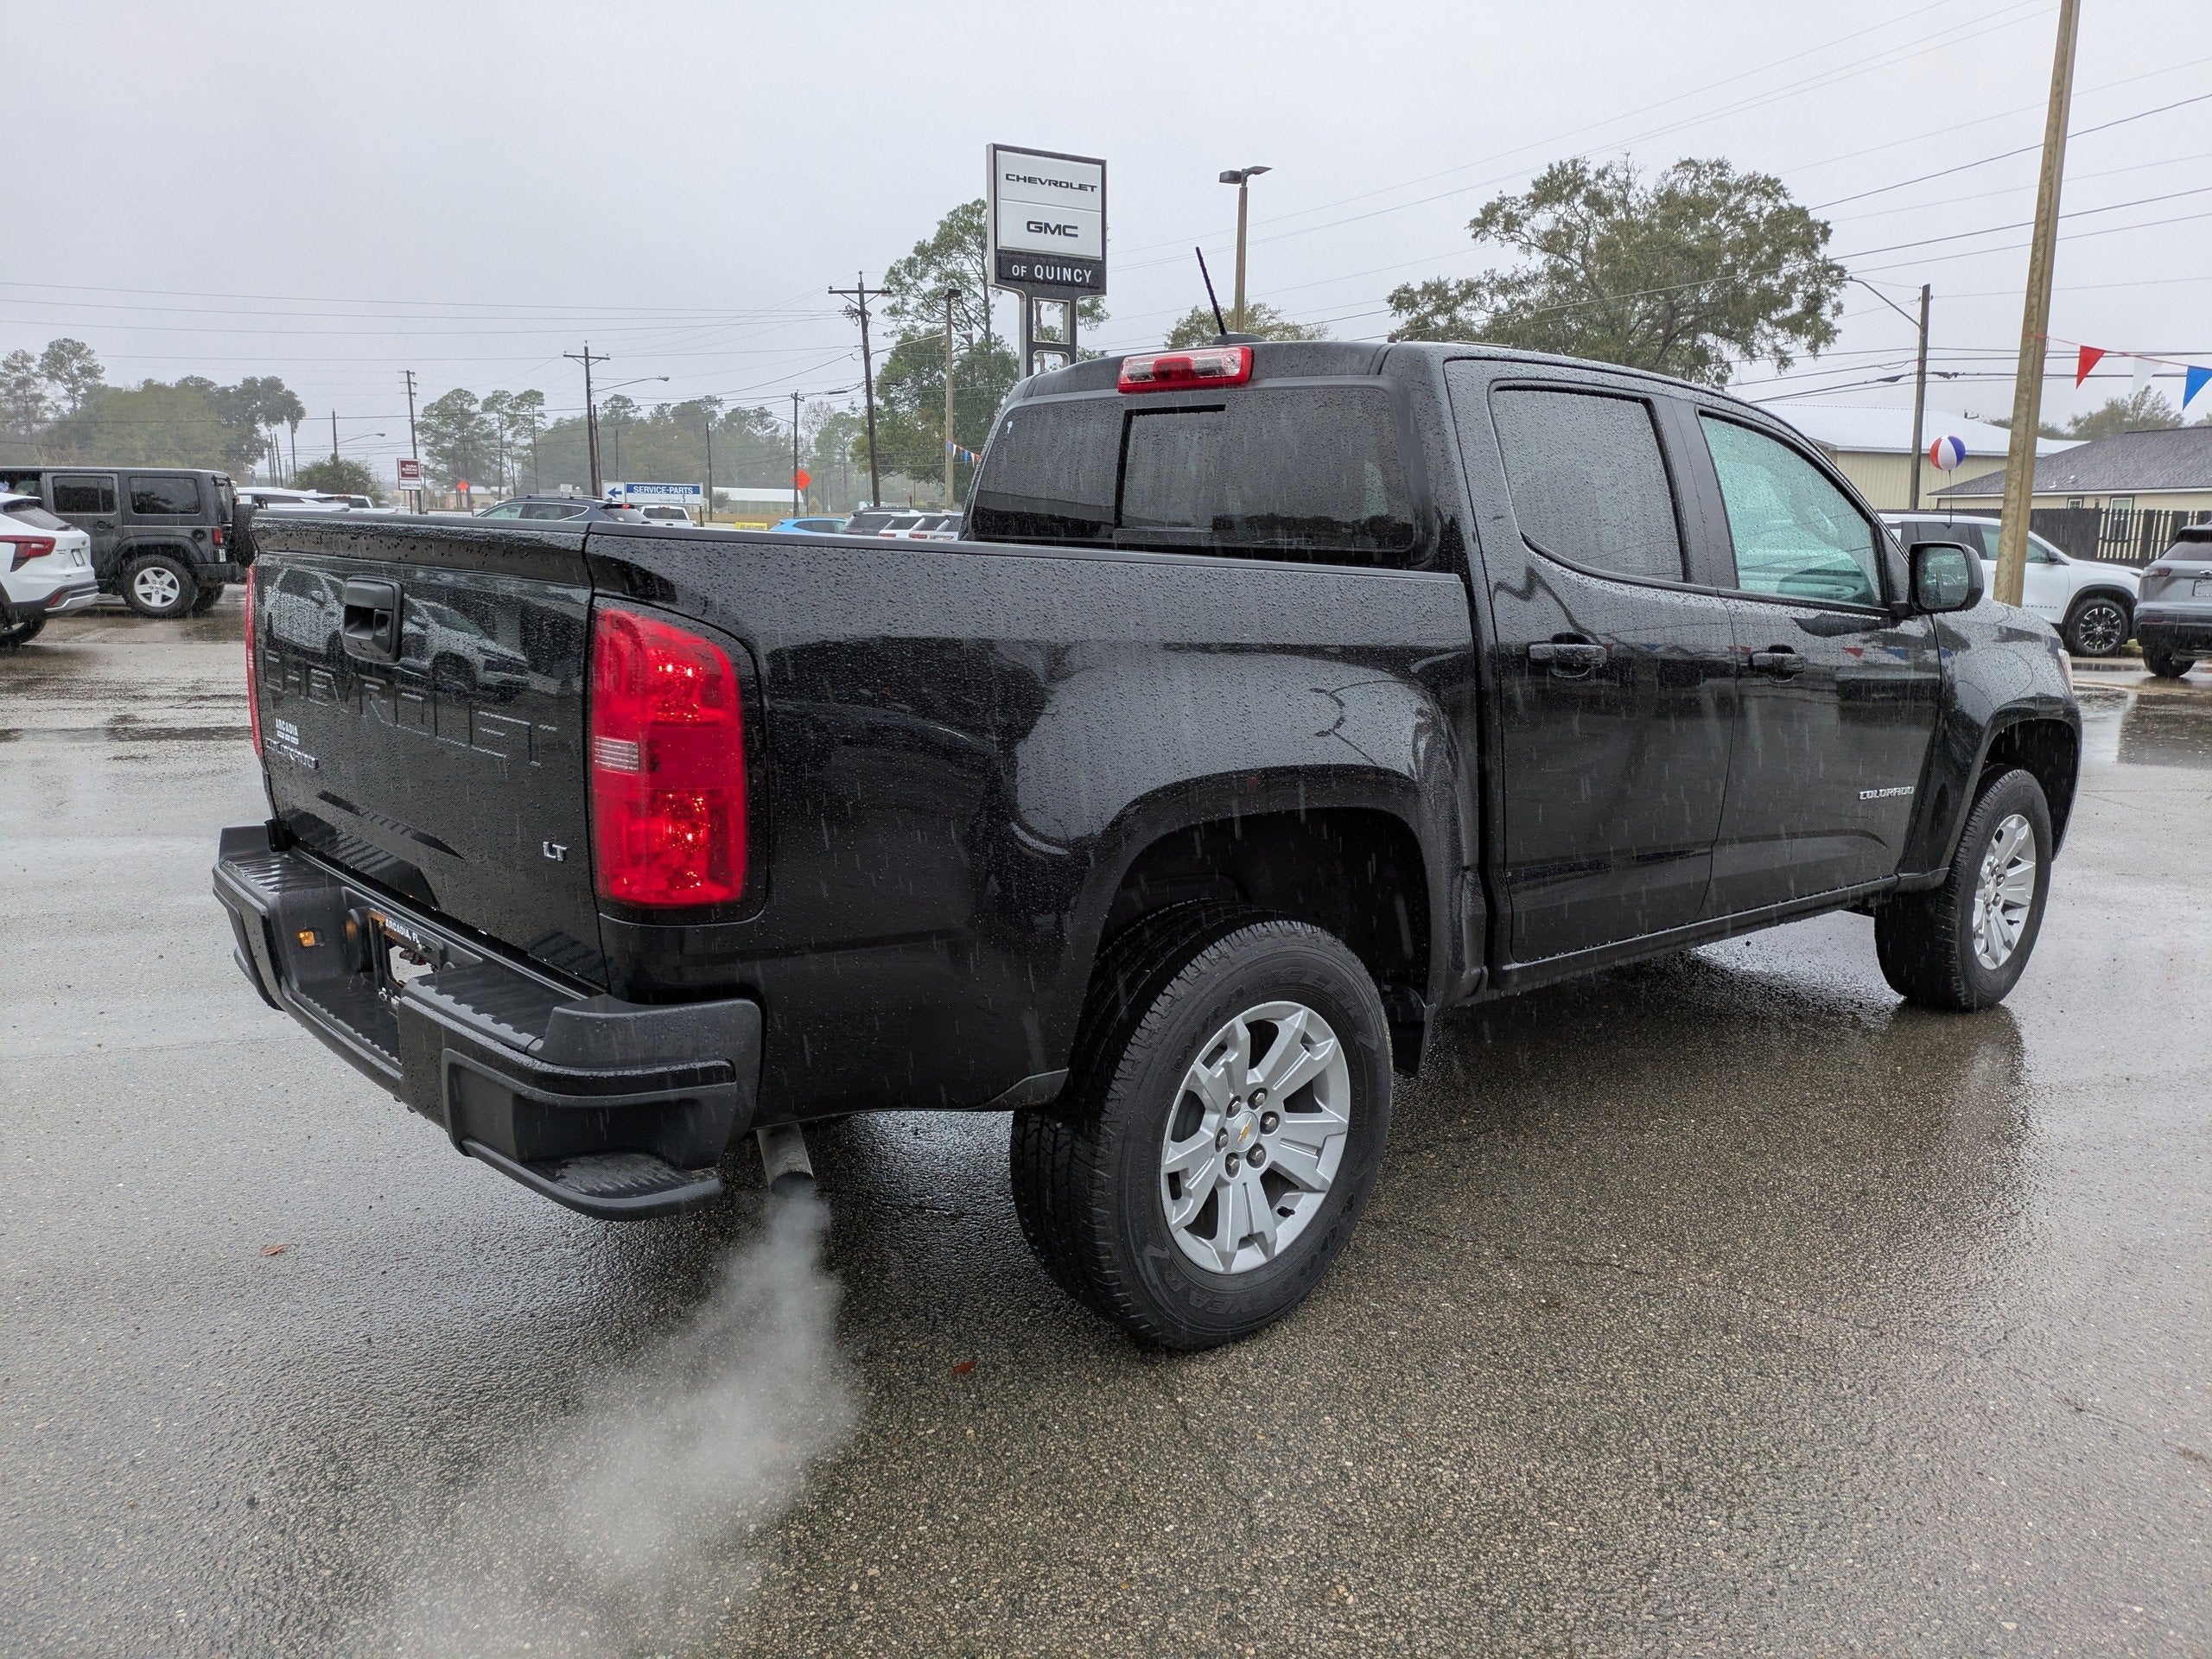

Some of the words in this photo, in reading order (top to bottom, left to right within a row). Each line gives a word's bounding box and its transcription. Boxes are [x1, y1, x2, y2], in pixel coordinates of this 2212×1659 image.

[1005, 173, 1097, 192] CHEVROLET
[1027, 220, 1078, 238] GMC
[1012, 264, 1027, 277] OF
[1034, 264, 1092, 283] QUINCY
[633, 486, 694, 494] SERVICE-PARTS
[276, 718, 299, 736] ARCADIA
[1859, 785, 1915, 800] COLORADO
[543, 841, 567, 861] LT
[385, 918, 412, 941] ARCADIA,
[412, 932, 420, 944] FL
